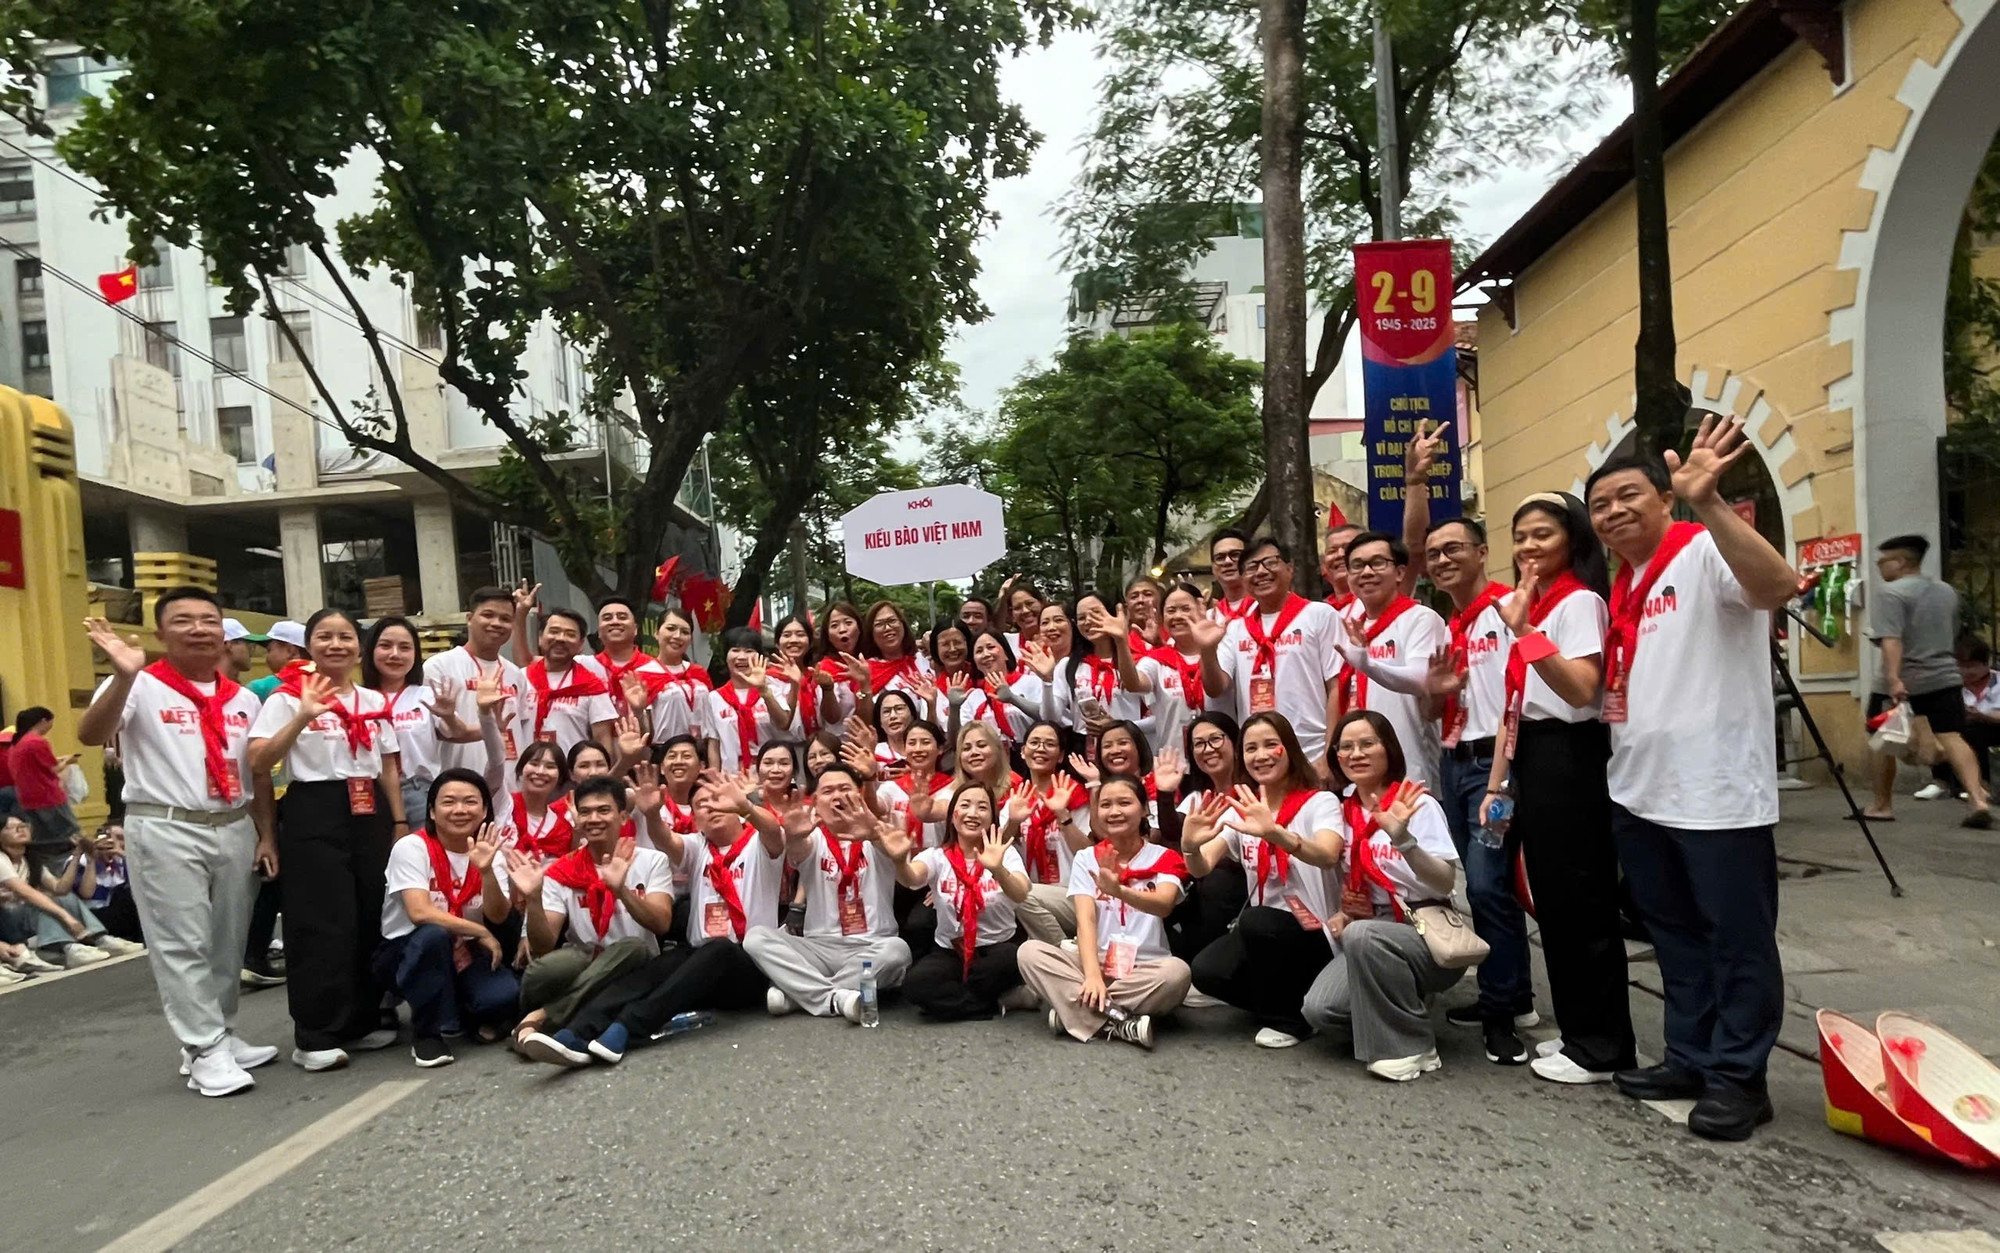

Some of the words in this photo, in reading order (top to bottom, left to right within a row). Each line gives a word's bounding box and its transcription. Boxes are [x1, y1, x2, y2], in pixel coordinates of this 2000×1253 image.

[1371, 269, 1436, 314] 2-9
[1376, 318, 1402, 331] 1945
[1410, 317, 1437, 330] 2025
[1373, 464, 1404, 478] TRONG
[1432, 485, 1443, 499] TA
[907, 496, 933, 509] KHỐI
[895, 525, 919, 546] BÀO
[922, 521, 948, 545] VIỆT
[952, 520, 982, 540] NAM
